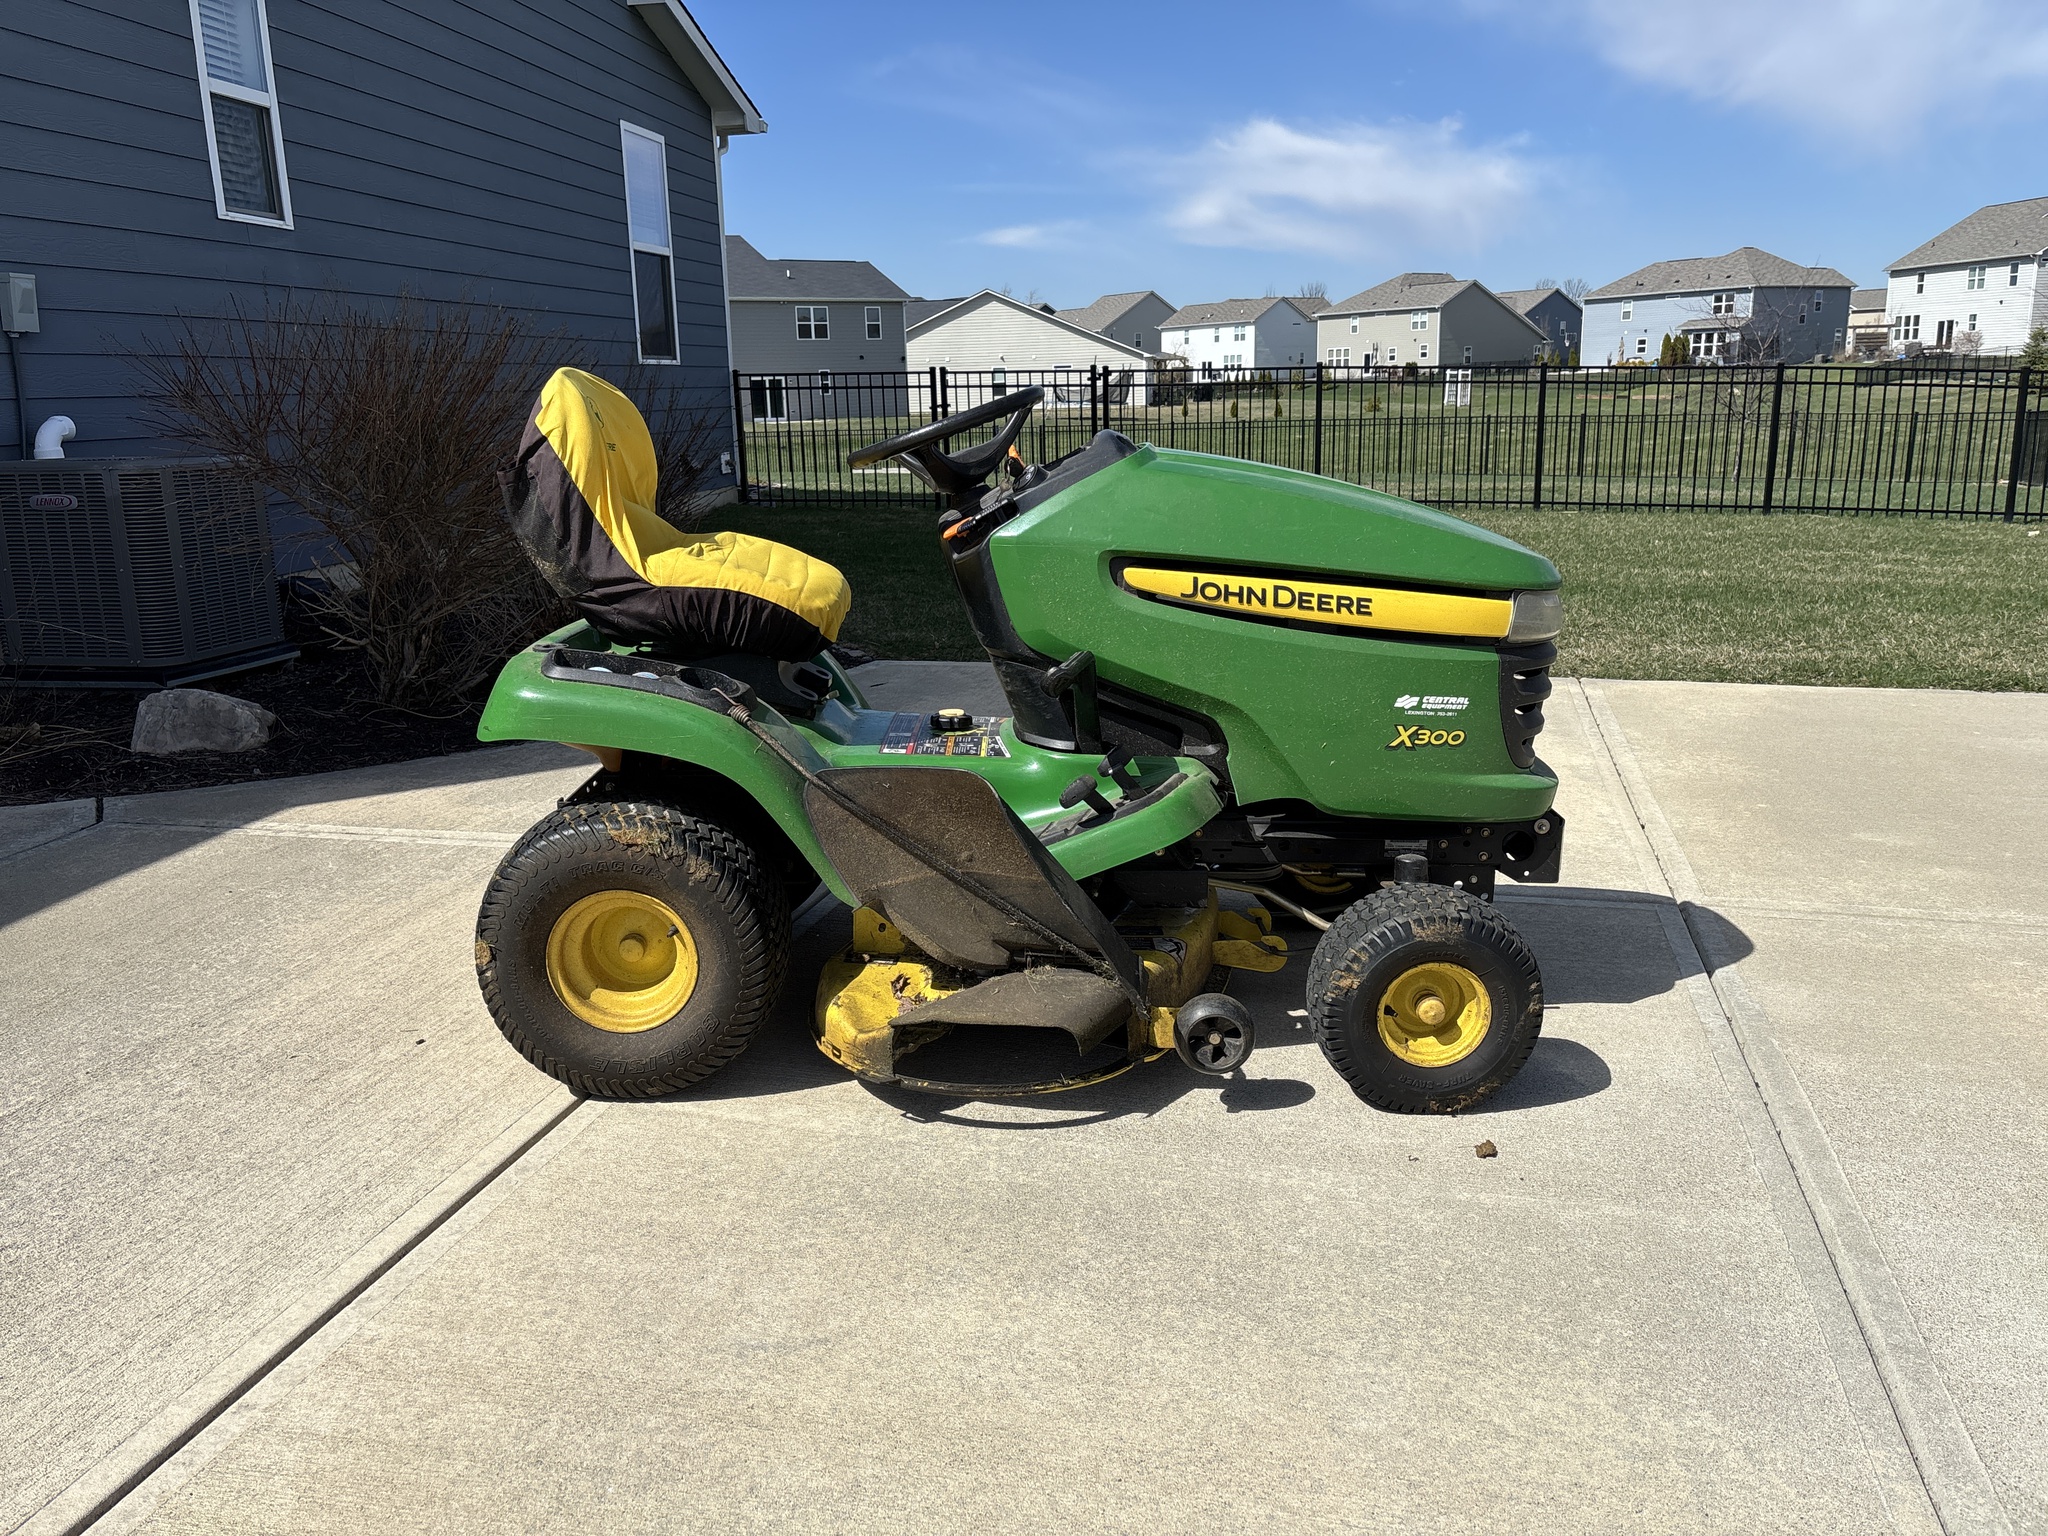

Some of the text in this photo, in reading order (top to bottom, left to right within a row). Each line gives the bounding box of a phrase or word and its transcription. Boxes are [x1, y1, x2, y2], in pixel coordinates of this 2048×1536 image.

[36, 497, 65, 506] LENNOX
[1181, 576, 1373, 616] JOHN DEERE
[1422, 695, 1470, 704] CENTRAL
[1385, 724, 1466, 750] X300
[513, 876, 561, 930] MULTI
[568, 860, 625, 880] TRAC
[588, 1011, 719, 1074] CARLISLE
